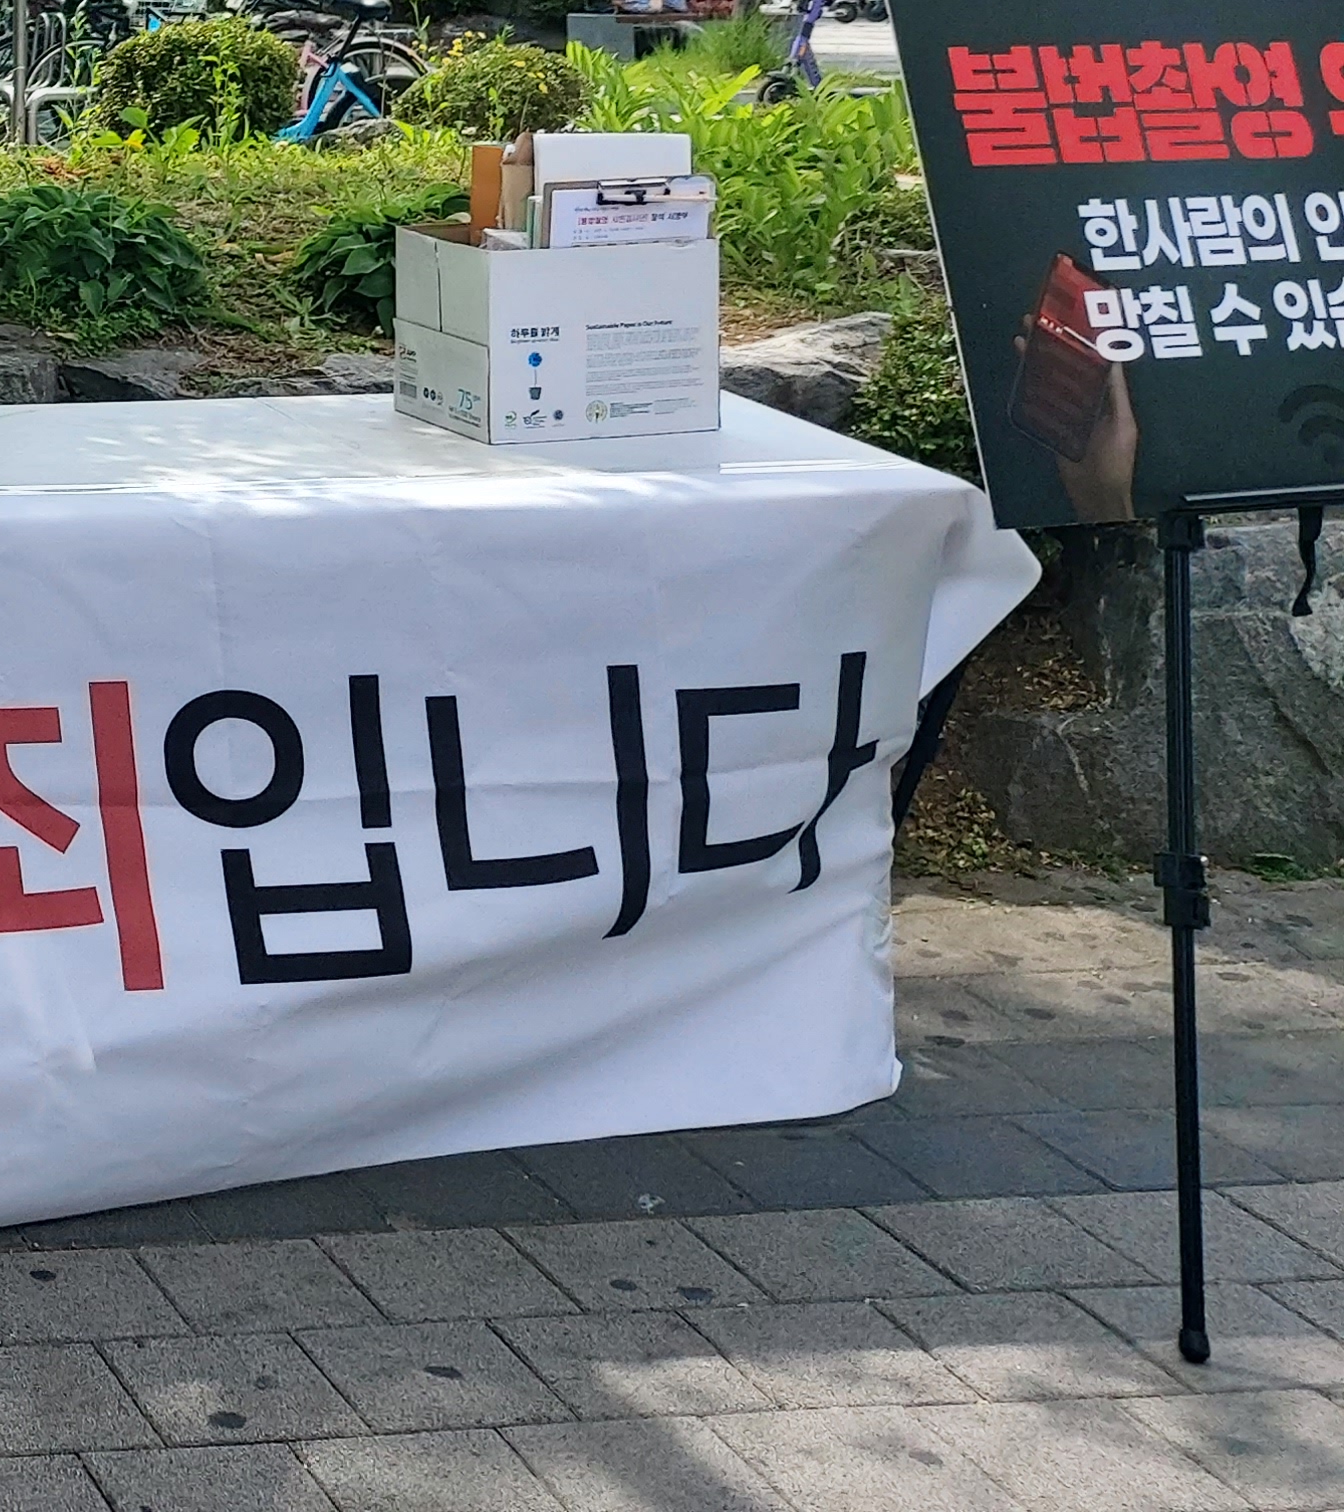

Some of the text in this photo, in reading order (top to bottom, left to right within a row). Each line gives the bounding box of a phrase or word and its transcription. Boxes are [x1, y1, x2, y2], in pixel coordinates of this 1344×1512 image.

[947, 40, 1313, 167] 불법촬영
[1078, 193, 1301, 273] 한사람의
[1084, 285, 1203, 363] 망칠
[1211, 283, 1268, 356] 수
